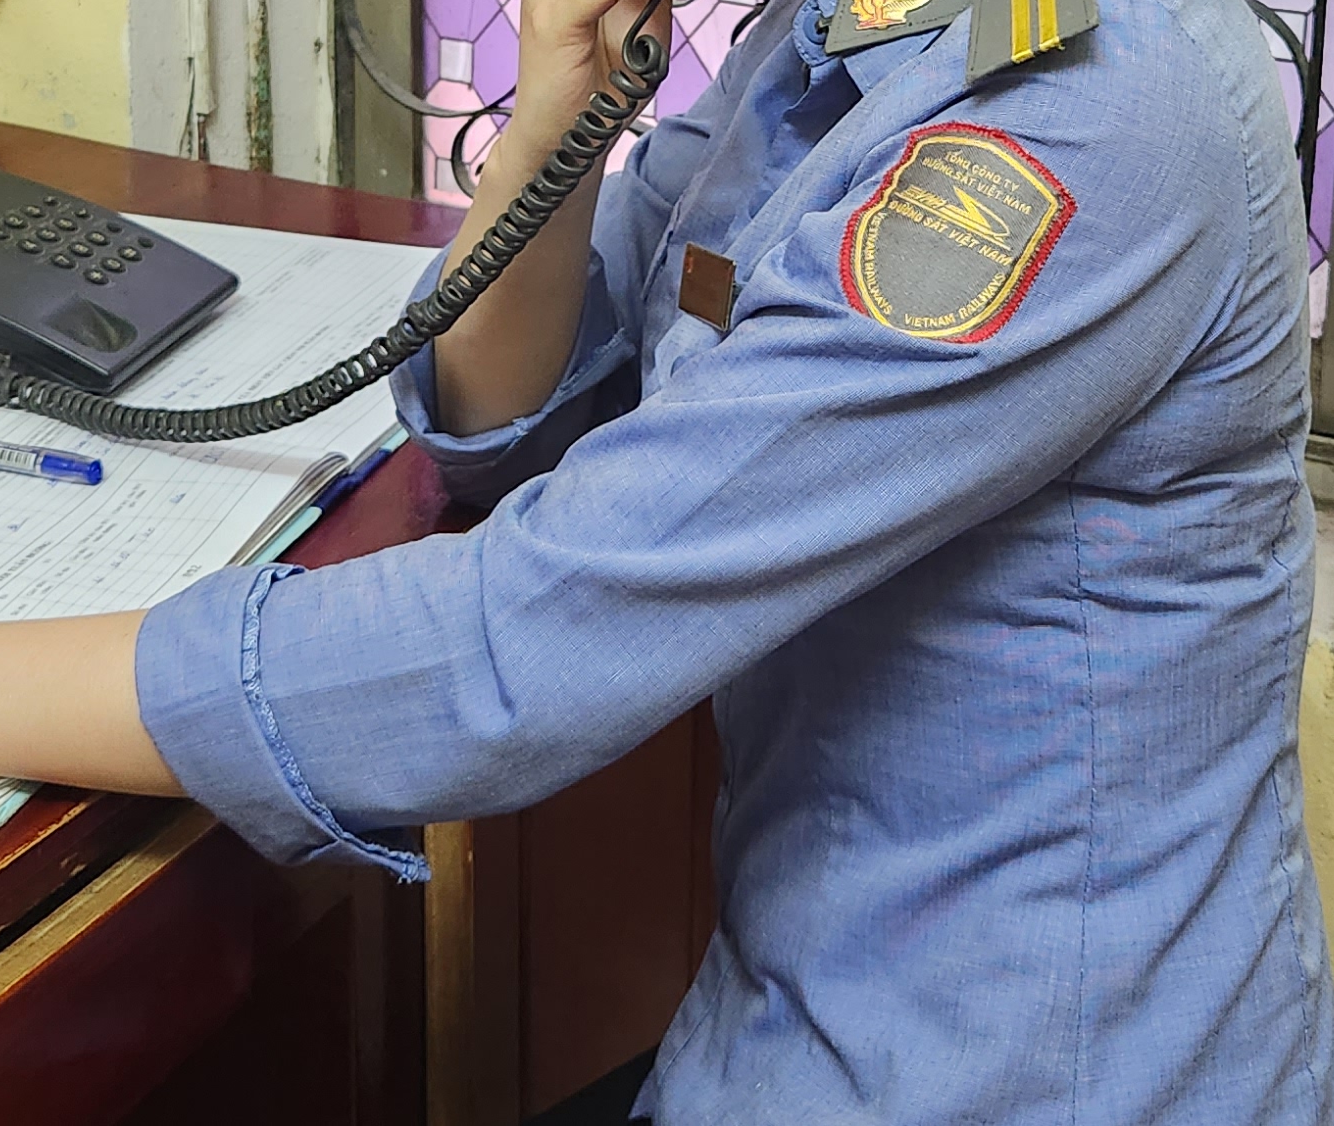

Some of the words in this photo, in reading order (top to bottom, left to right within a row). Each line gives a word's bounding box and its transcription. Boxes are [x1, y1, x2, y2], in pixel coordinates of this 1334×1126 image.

[1003, 194, 1033, 215] NAM
[978, 244, 1014, 267] NAM
[904, 312, 956, 328] VIETNAM
[958, 271, 1007, 320] RAILWAYS
